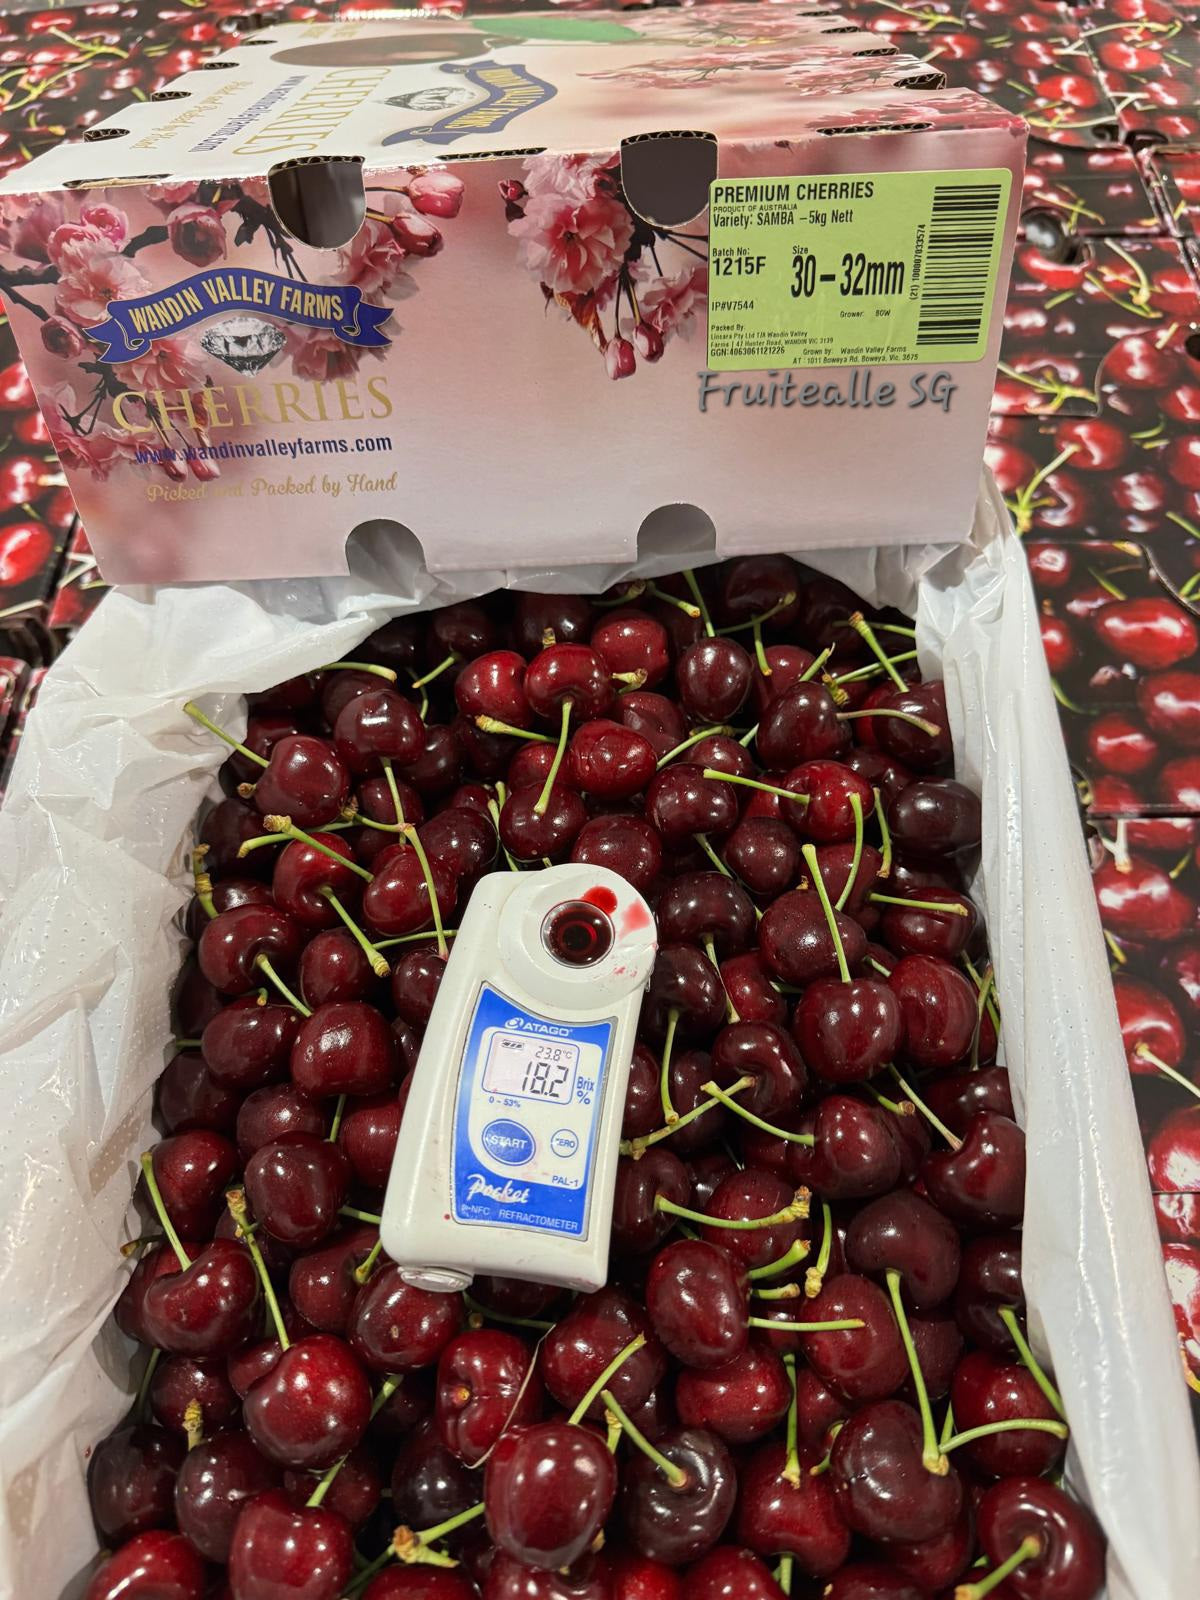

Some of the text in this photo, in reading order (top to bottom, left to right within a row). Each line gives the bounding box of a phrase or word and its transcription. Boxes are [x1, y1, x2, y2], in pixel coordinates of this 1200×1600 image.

[232, 67, 392, 155] CHERRIES
[714, 181, 874, 203] PREMIUM CHERRIES
[713, 203, 798, 213] PRODUCT OF AUSTRALIA
[713, 213, 753, 229] Variety:
[757, 211, 794, 226] SAMBA
[831, 209, 853, 223] Nett
[712, 246, 750, 257] Batch No:
[792, 245, 808, 255] Size
[712, 256, 766, 276] 1215F
[908, 284, 920, 301] (21)
[128, 275, 345, 334] WANDIN VALLEY FARMS
[711, 300, 754, 311] IP#V7544
[710, 324, 734, 332] Packed
[802, 348, 823, 356] Grown
[840, 346, 863, 354] Wandin
[865, 346, 885, 355] Valley
[886, 345, 907, 353] Farms
[111, 375, 394, 433] CHERRIES
[134, 435, 393, 465] www.wandinvalleyfarms.com
[147, 483, 209, 502] Picked
[250, 474, 317, 497] Packed
[321, 474, 341, 498] by
[346, 471, 398, 492] Hand
[522, 1061, 569, 1098] 18.2
[576, 1076, 595, 1092] Brix
[576, 1090, 591, 1105] %
[489, 1135, 528, 1149] START
[467, 1173, 531, 1204] Pocket
[552, 1175, 579, 1187] PAL-1
[499, 1208, 578, 1231] REFRACTOMETER
